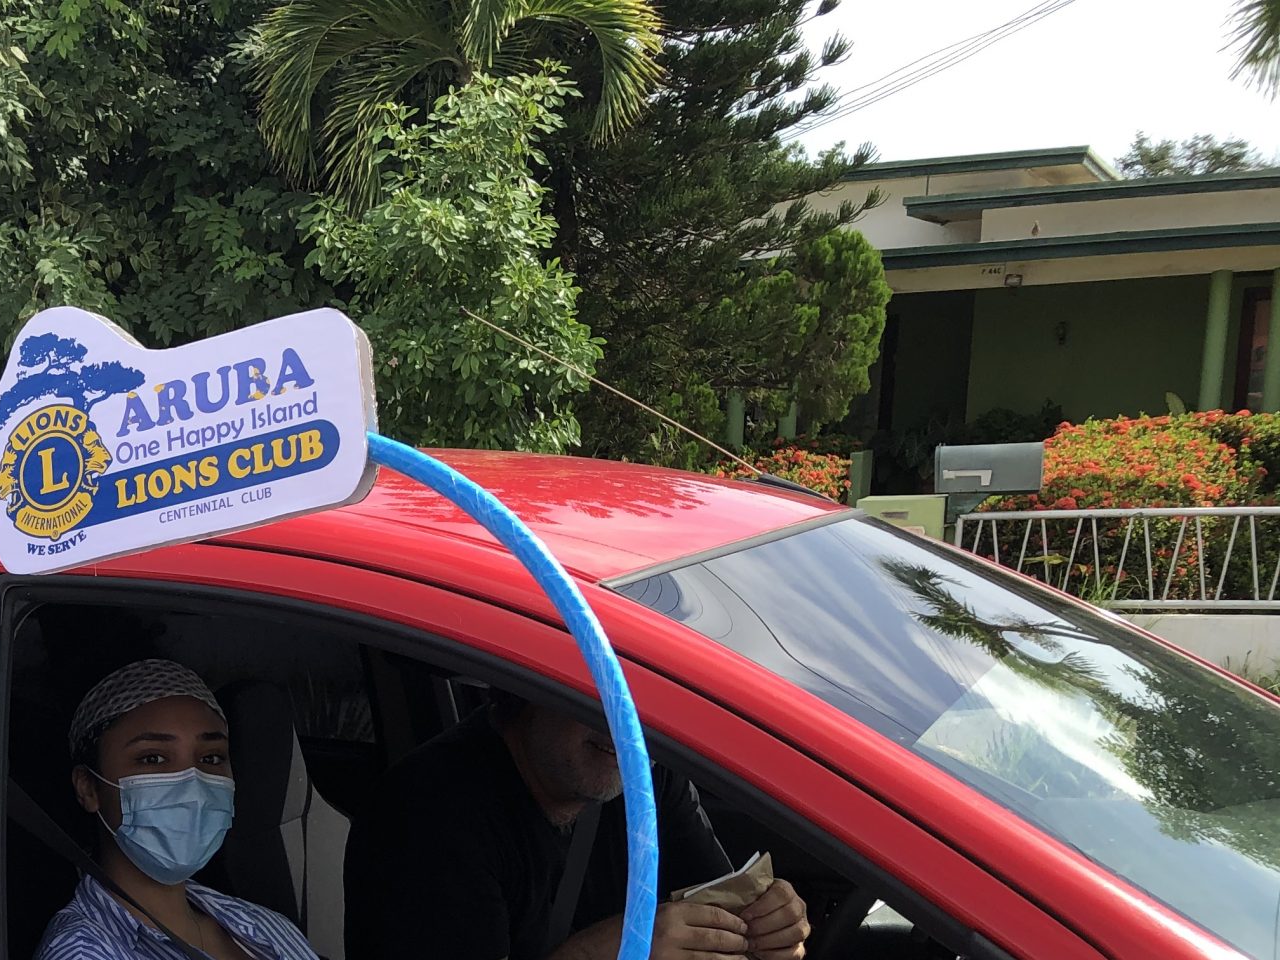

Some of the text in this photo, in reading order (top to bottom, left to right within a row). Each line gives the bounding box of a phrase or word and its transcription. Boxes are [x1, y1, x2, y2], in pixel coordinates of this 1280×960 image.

[116, 348, 315, 437] ARUBA
[15, 409, 83, 446] LIONS
[116, 391, 318, 464] One Happy Island
[37, 447, 70, 495] L
[115, 429, 324, 508] LIONS CLUB
[20, 499, 88, 531] INTERNATIONAL
[158, 486, 273, 524] CENTENNIAL CLUB
[27, 530, 87, 555] WE SERVE
